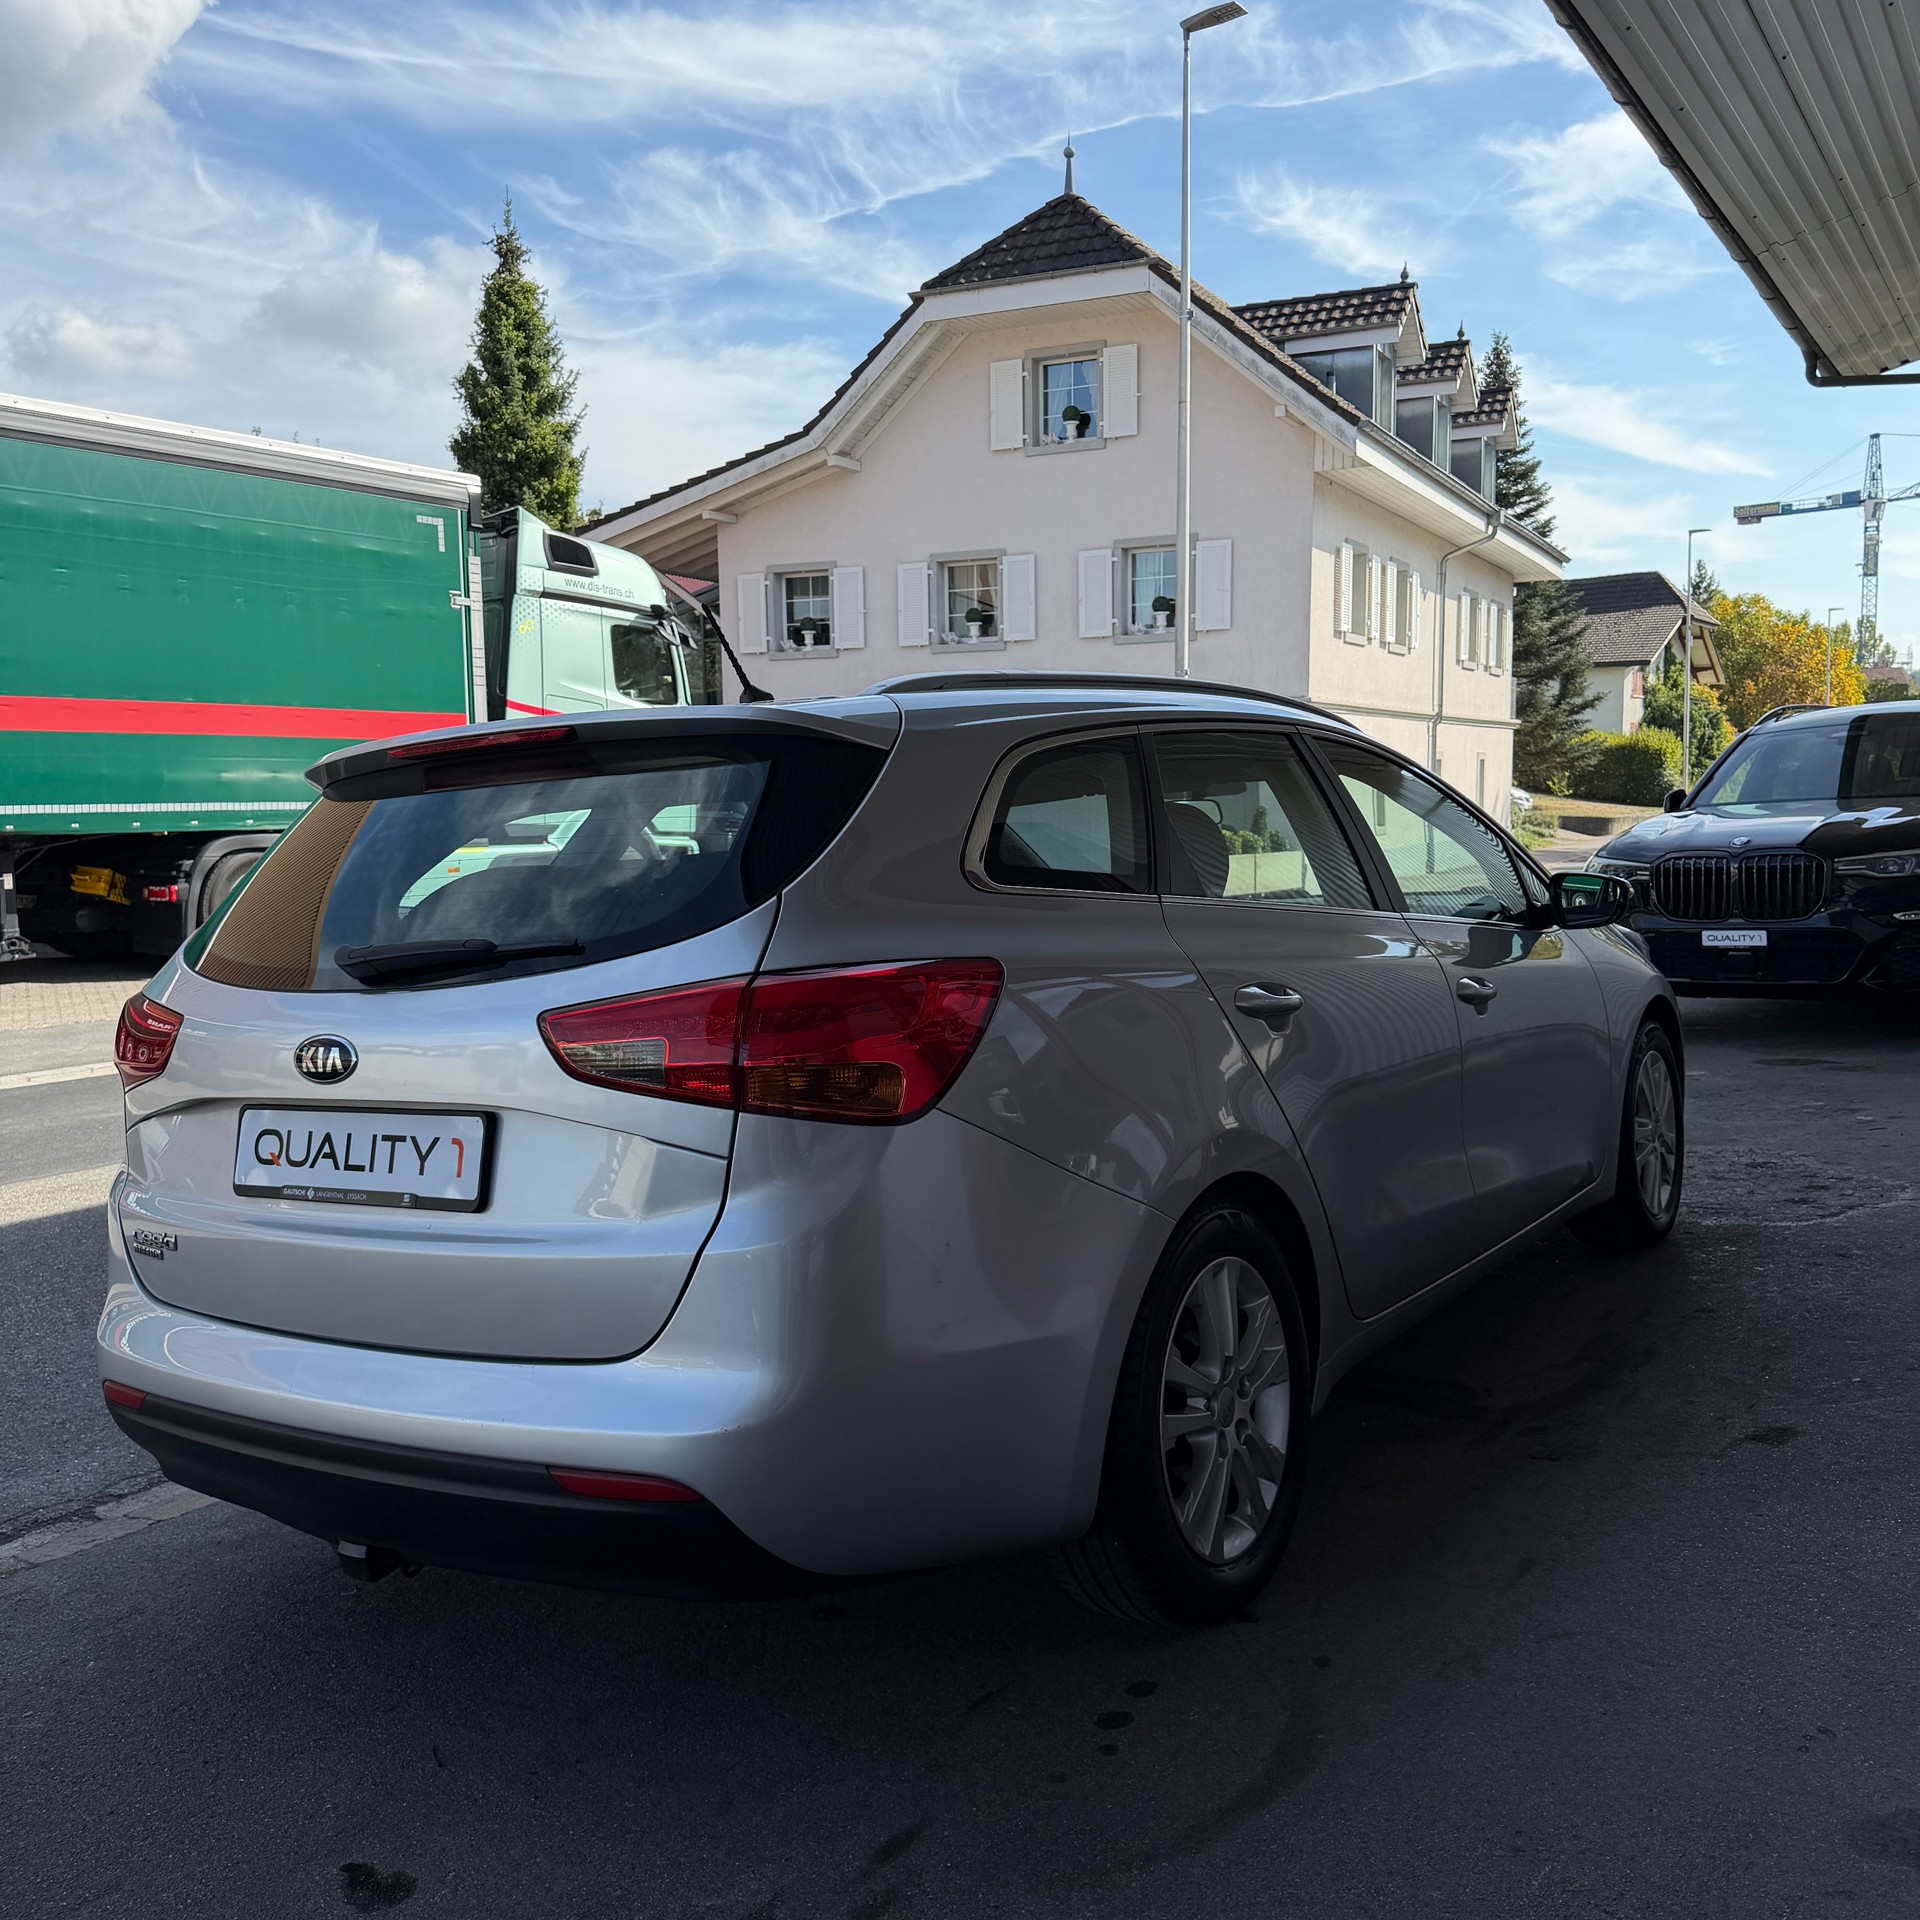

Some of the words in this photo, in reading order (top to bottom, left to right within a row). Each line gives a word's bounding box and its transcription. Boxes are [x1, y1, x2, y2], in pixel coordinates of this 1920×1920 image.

[1706, 934, 1756, 942] QUALITY
[302, 1046, 345, 1073] KIA
[254, 1128, 441, 1176] QUALITY
[451, 1137, 465, 1178] 1
